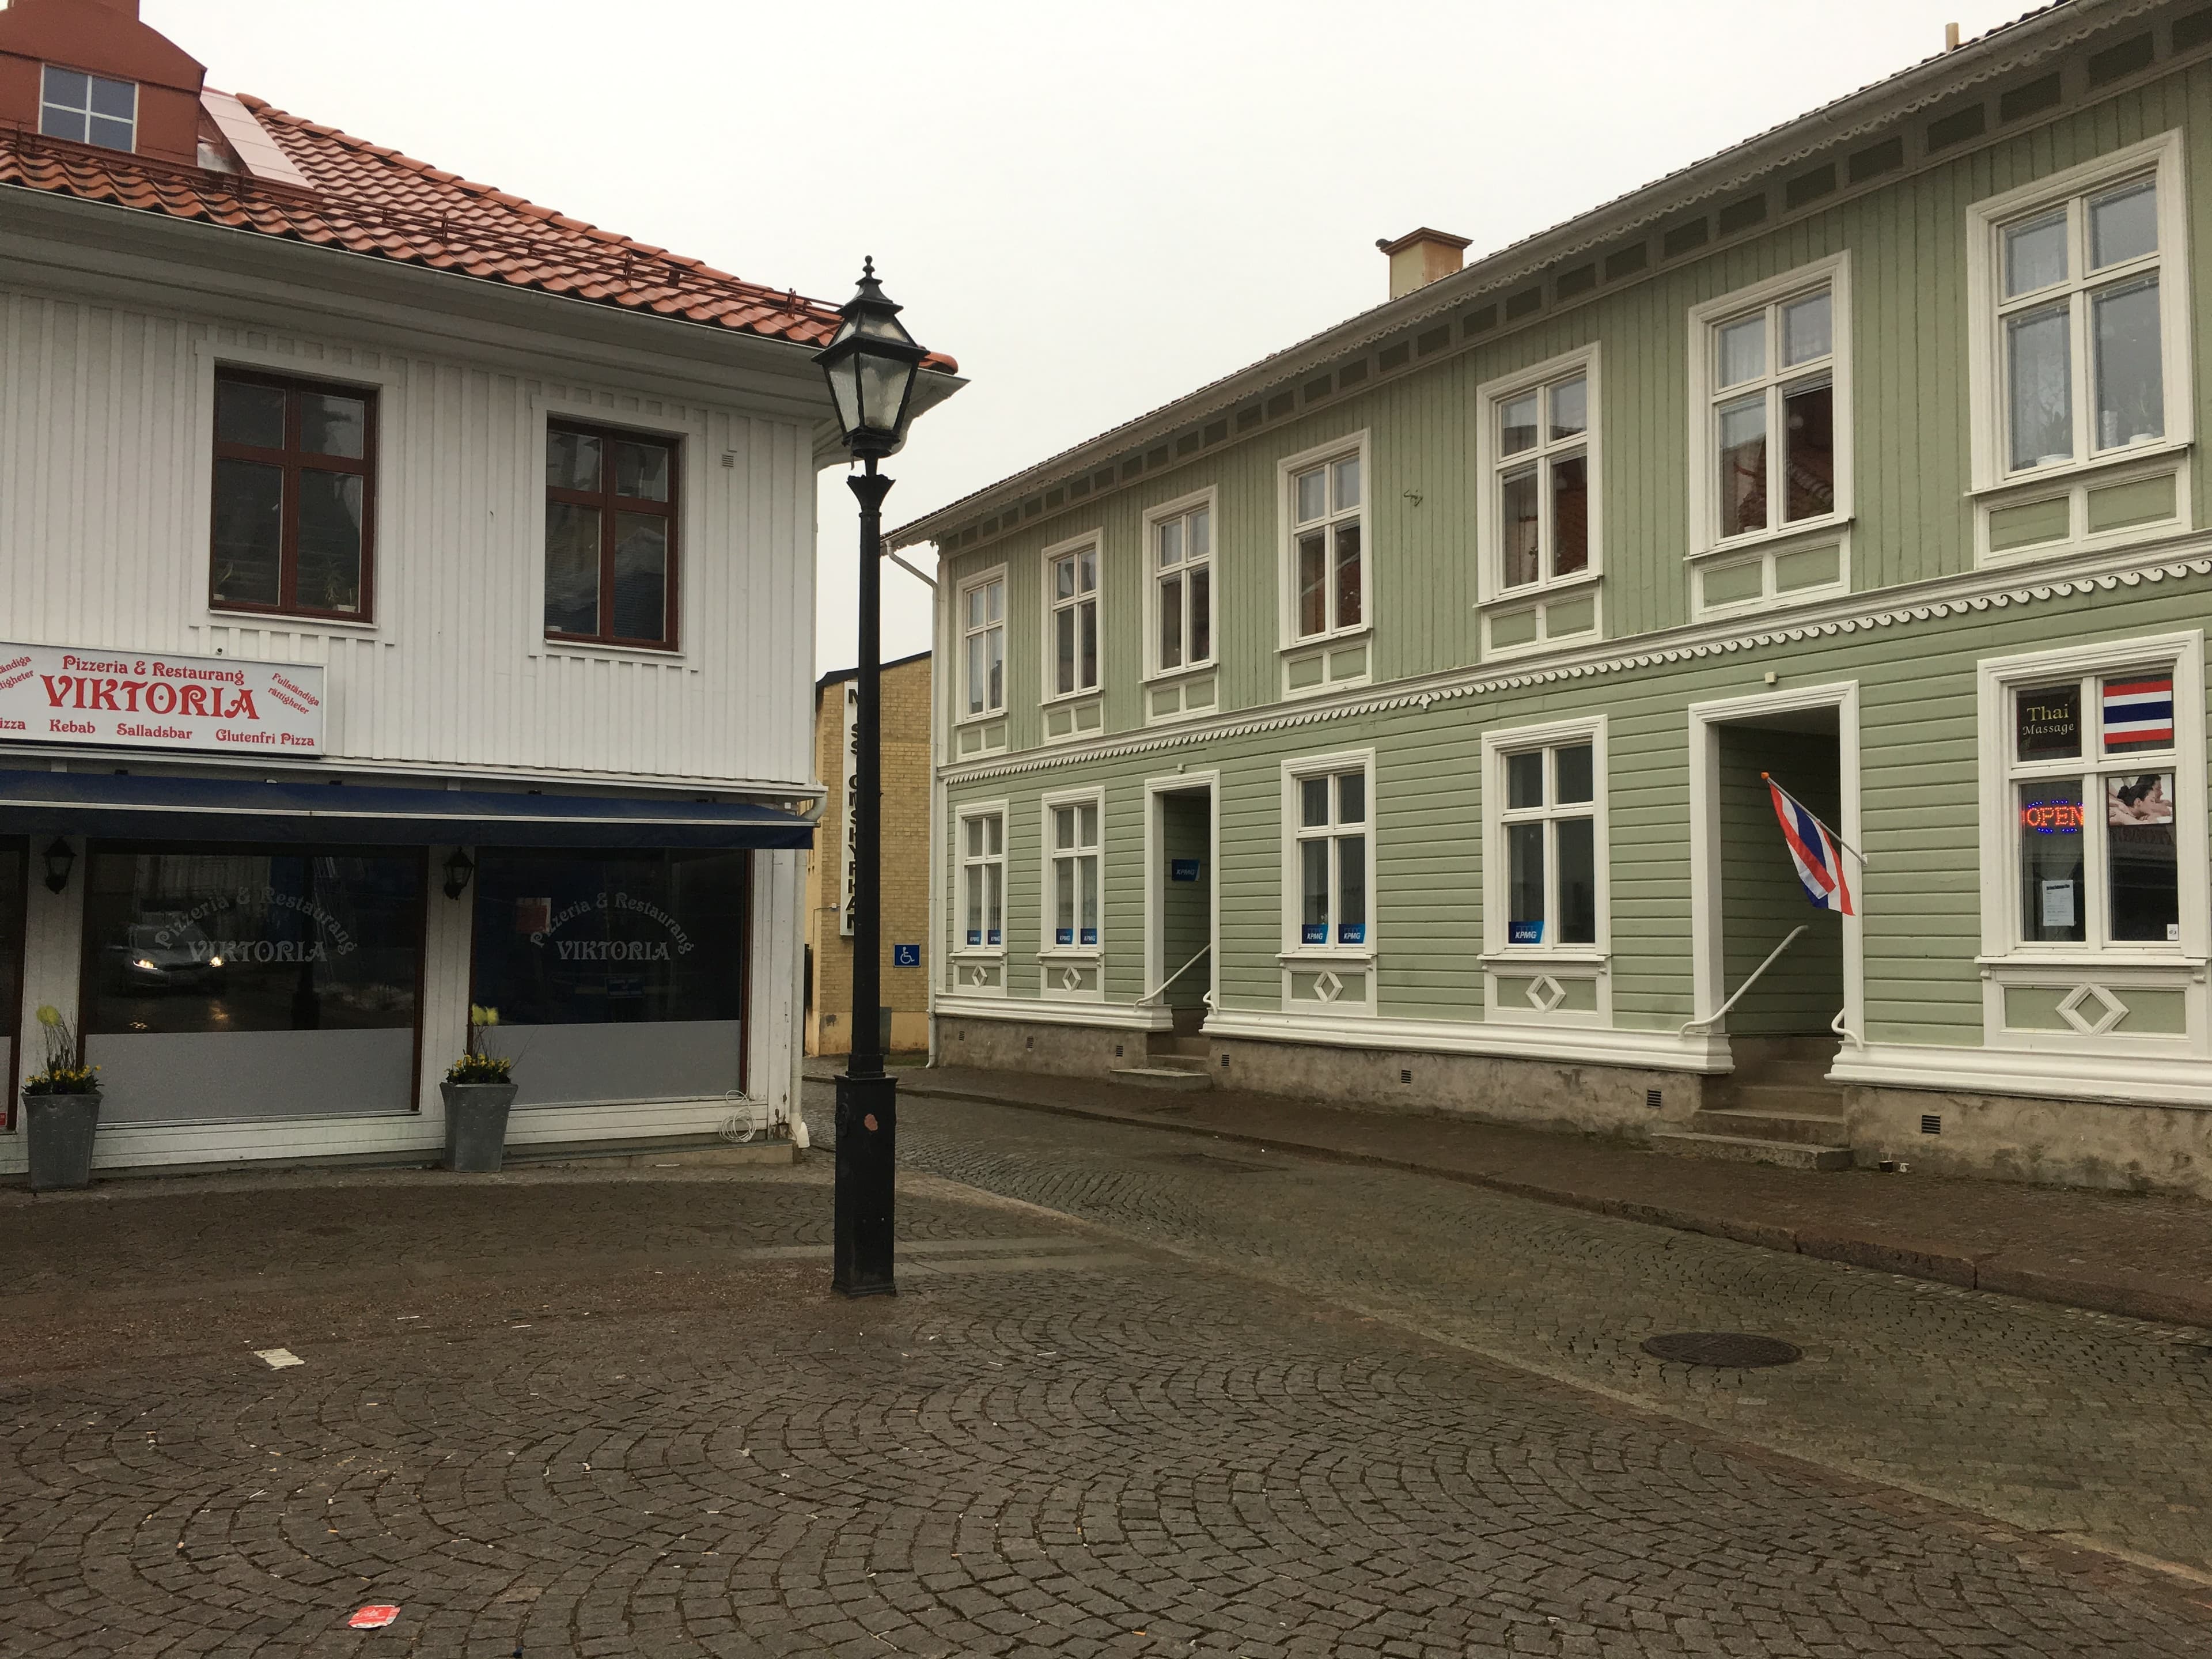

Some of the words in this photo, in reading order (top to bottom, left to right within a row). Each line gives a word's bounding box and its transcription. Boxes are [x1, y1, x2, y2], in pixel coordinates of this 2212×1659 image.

[0, 656, 32, 674] ändiga
[63, 655, 128, 674] Pizzeria
[134, 661, 146, 676] &
[152, 662, 244, 685] Restaurang
[0, 670, 34, 690] tigheter
[271, 673, 319, 706] Fullständiga
[40, 674, 260, 719] VIKTORIA
[268, 687, 309, 714] rättigheter
[2027, 703, 2069, 722] Thai
[0, 717, 26, 730] izza
[50, 719, 96, 734] Kebab
[116, 723, 192, 739] Salladsbar
[215, 729, 275, 744] Glutenfri
[281, 733, 315, 747] Pizza
[2022, 723, 2074, 736] Massage
[2026, 806, 2084, 827] OPEN
[154, 896, 229, 949] Pizzeria
[236, 887, 251, 905] &
[260, 887, 358, 956] Restaurang
[530, 900, 591, 948] Pizzeria
[596, 892, 608, 908] &
[615, 892, 695, 955] Restaurang
[1515, 930, 1537, 939] KPMG
[186, 940, 328, 963] VIKTORIA
[555, 940, 671, 960] VIKTORIA
